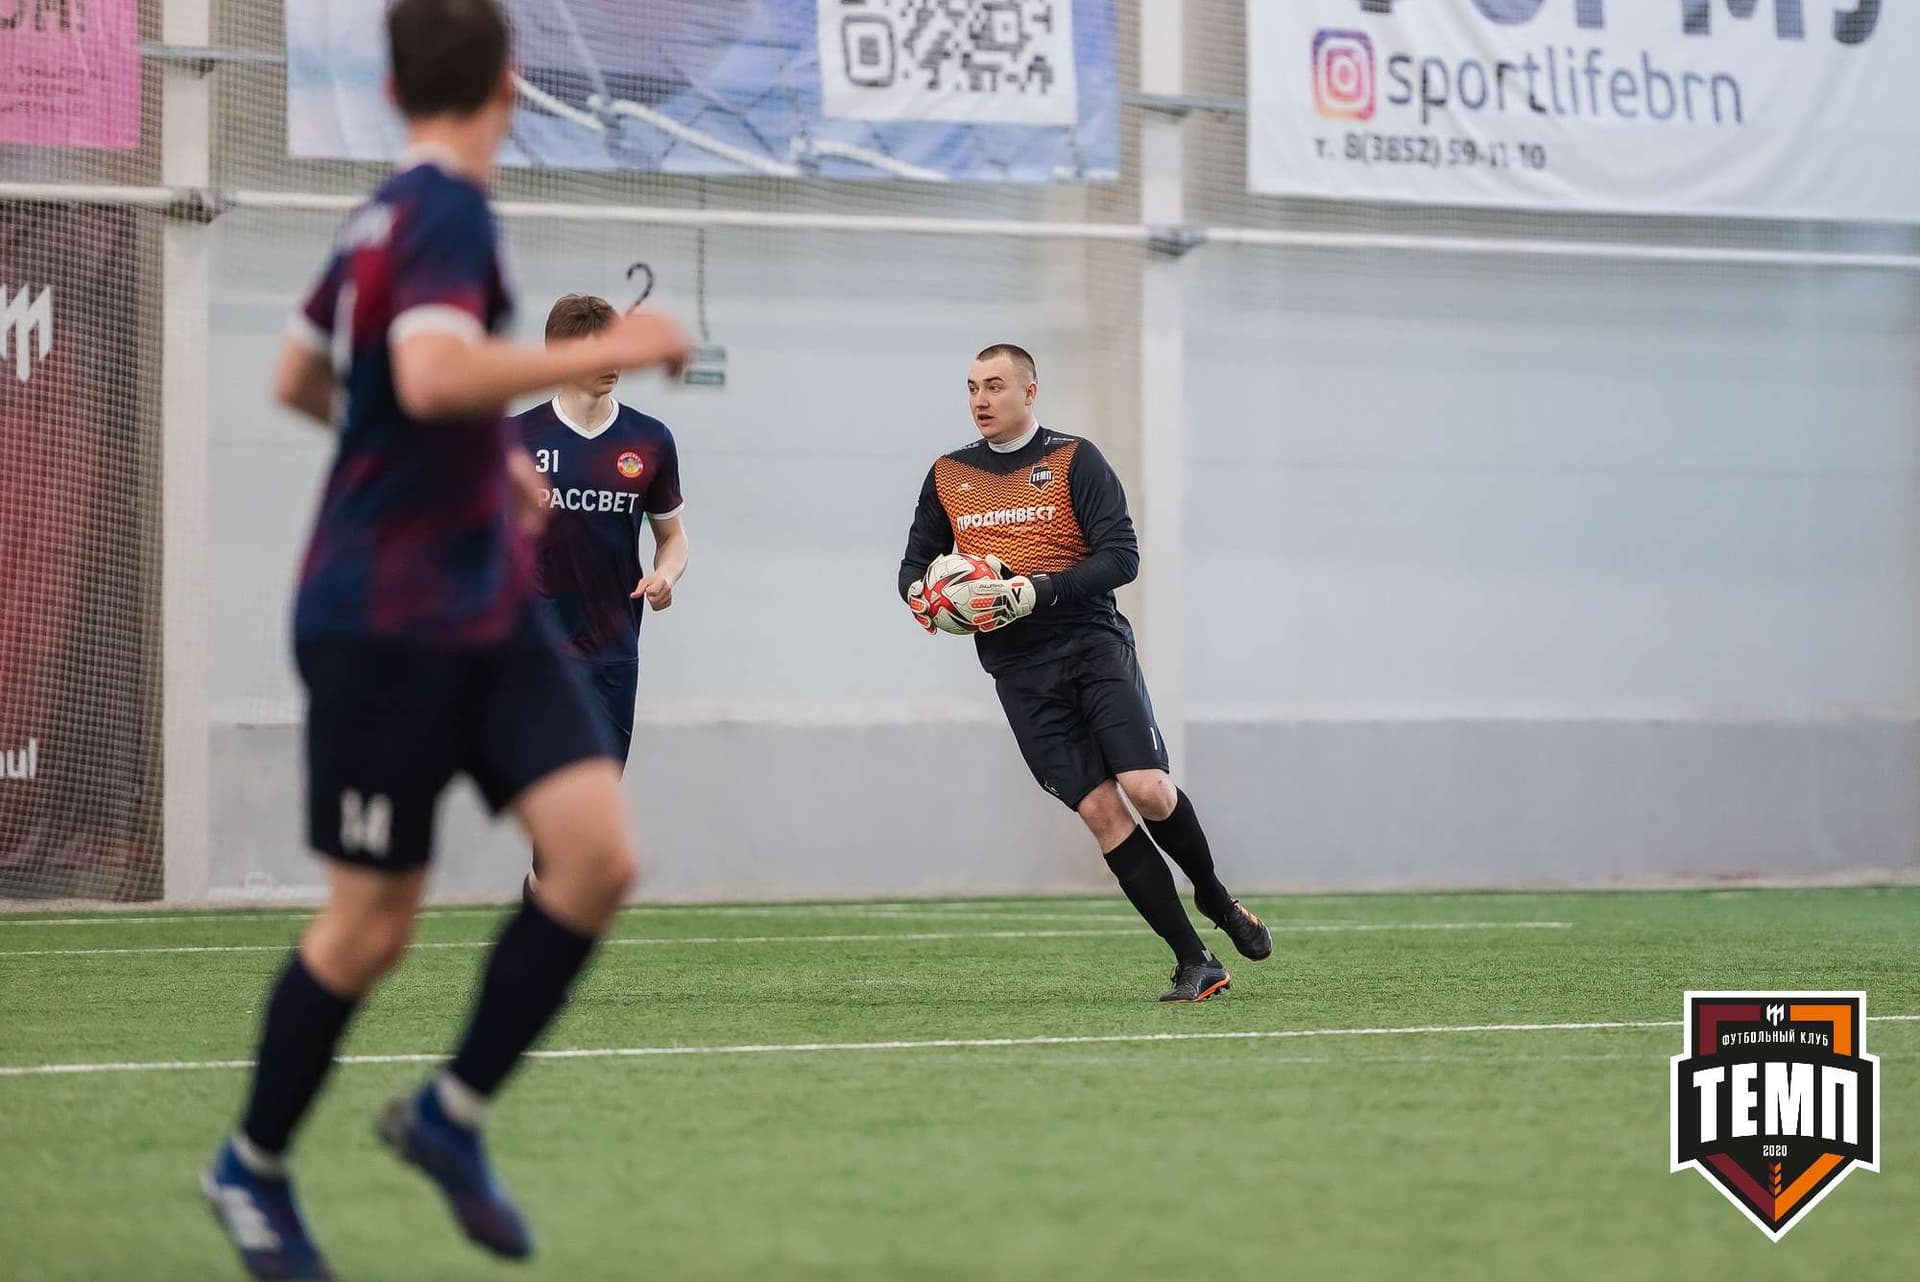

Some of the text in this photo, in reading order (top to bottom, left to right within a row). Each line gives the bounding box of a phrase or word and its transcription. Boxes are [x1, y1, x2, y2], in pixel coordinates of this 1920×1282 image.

[1387, 46, 1744, 125] sportlifebrn
[535, 448, 560, 473] 31
[956, 506, 1057, 532] ПРОДИНВЕСТ
